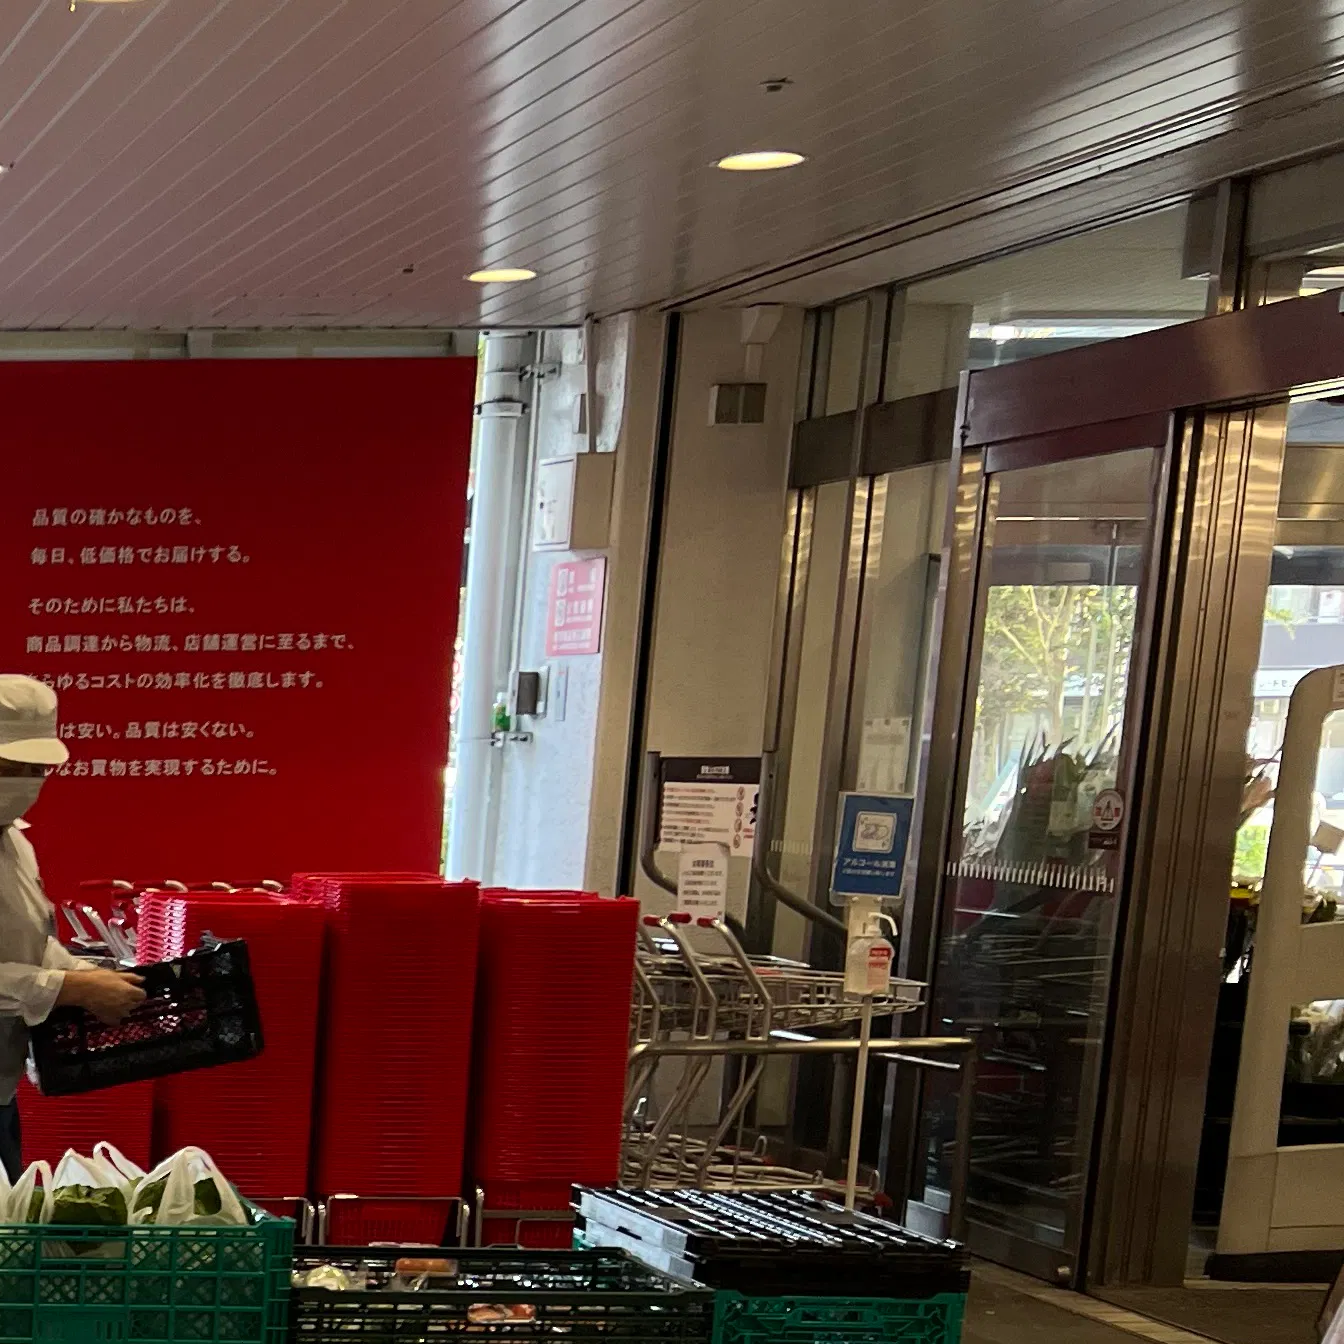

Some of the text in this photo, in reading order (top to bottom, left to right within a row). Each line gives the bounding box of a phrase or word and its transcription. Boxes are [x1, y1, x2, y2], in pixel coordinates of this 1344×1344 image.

[32, 506, 202, 527] 品質の確かなものを、
[27, 596, 195, 615] そのために私たちは、
[59, 721, 254, 740] は安い。品質は安くない。
